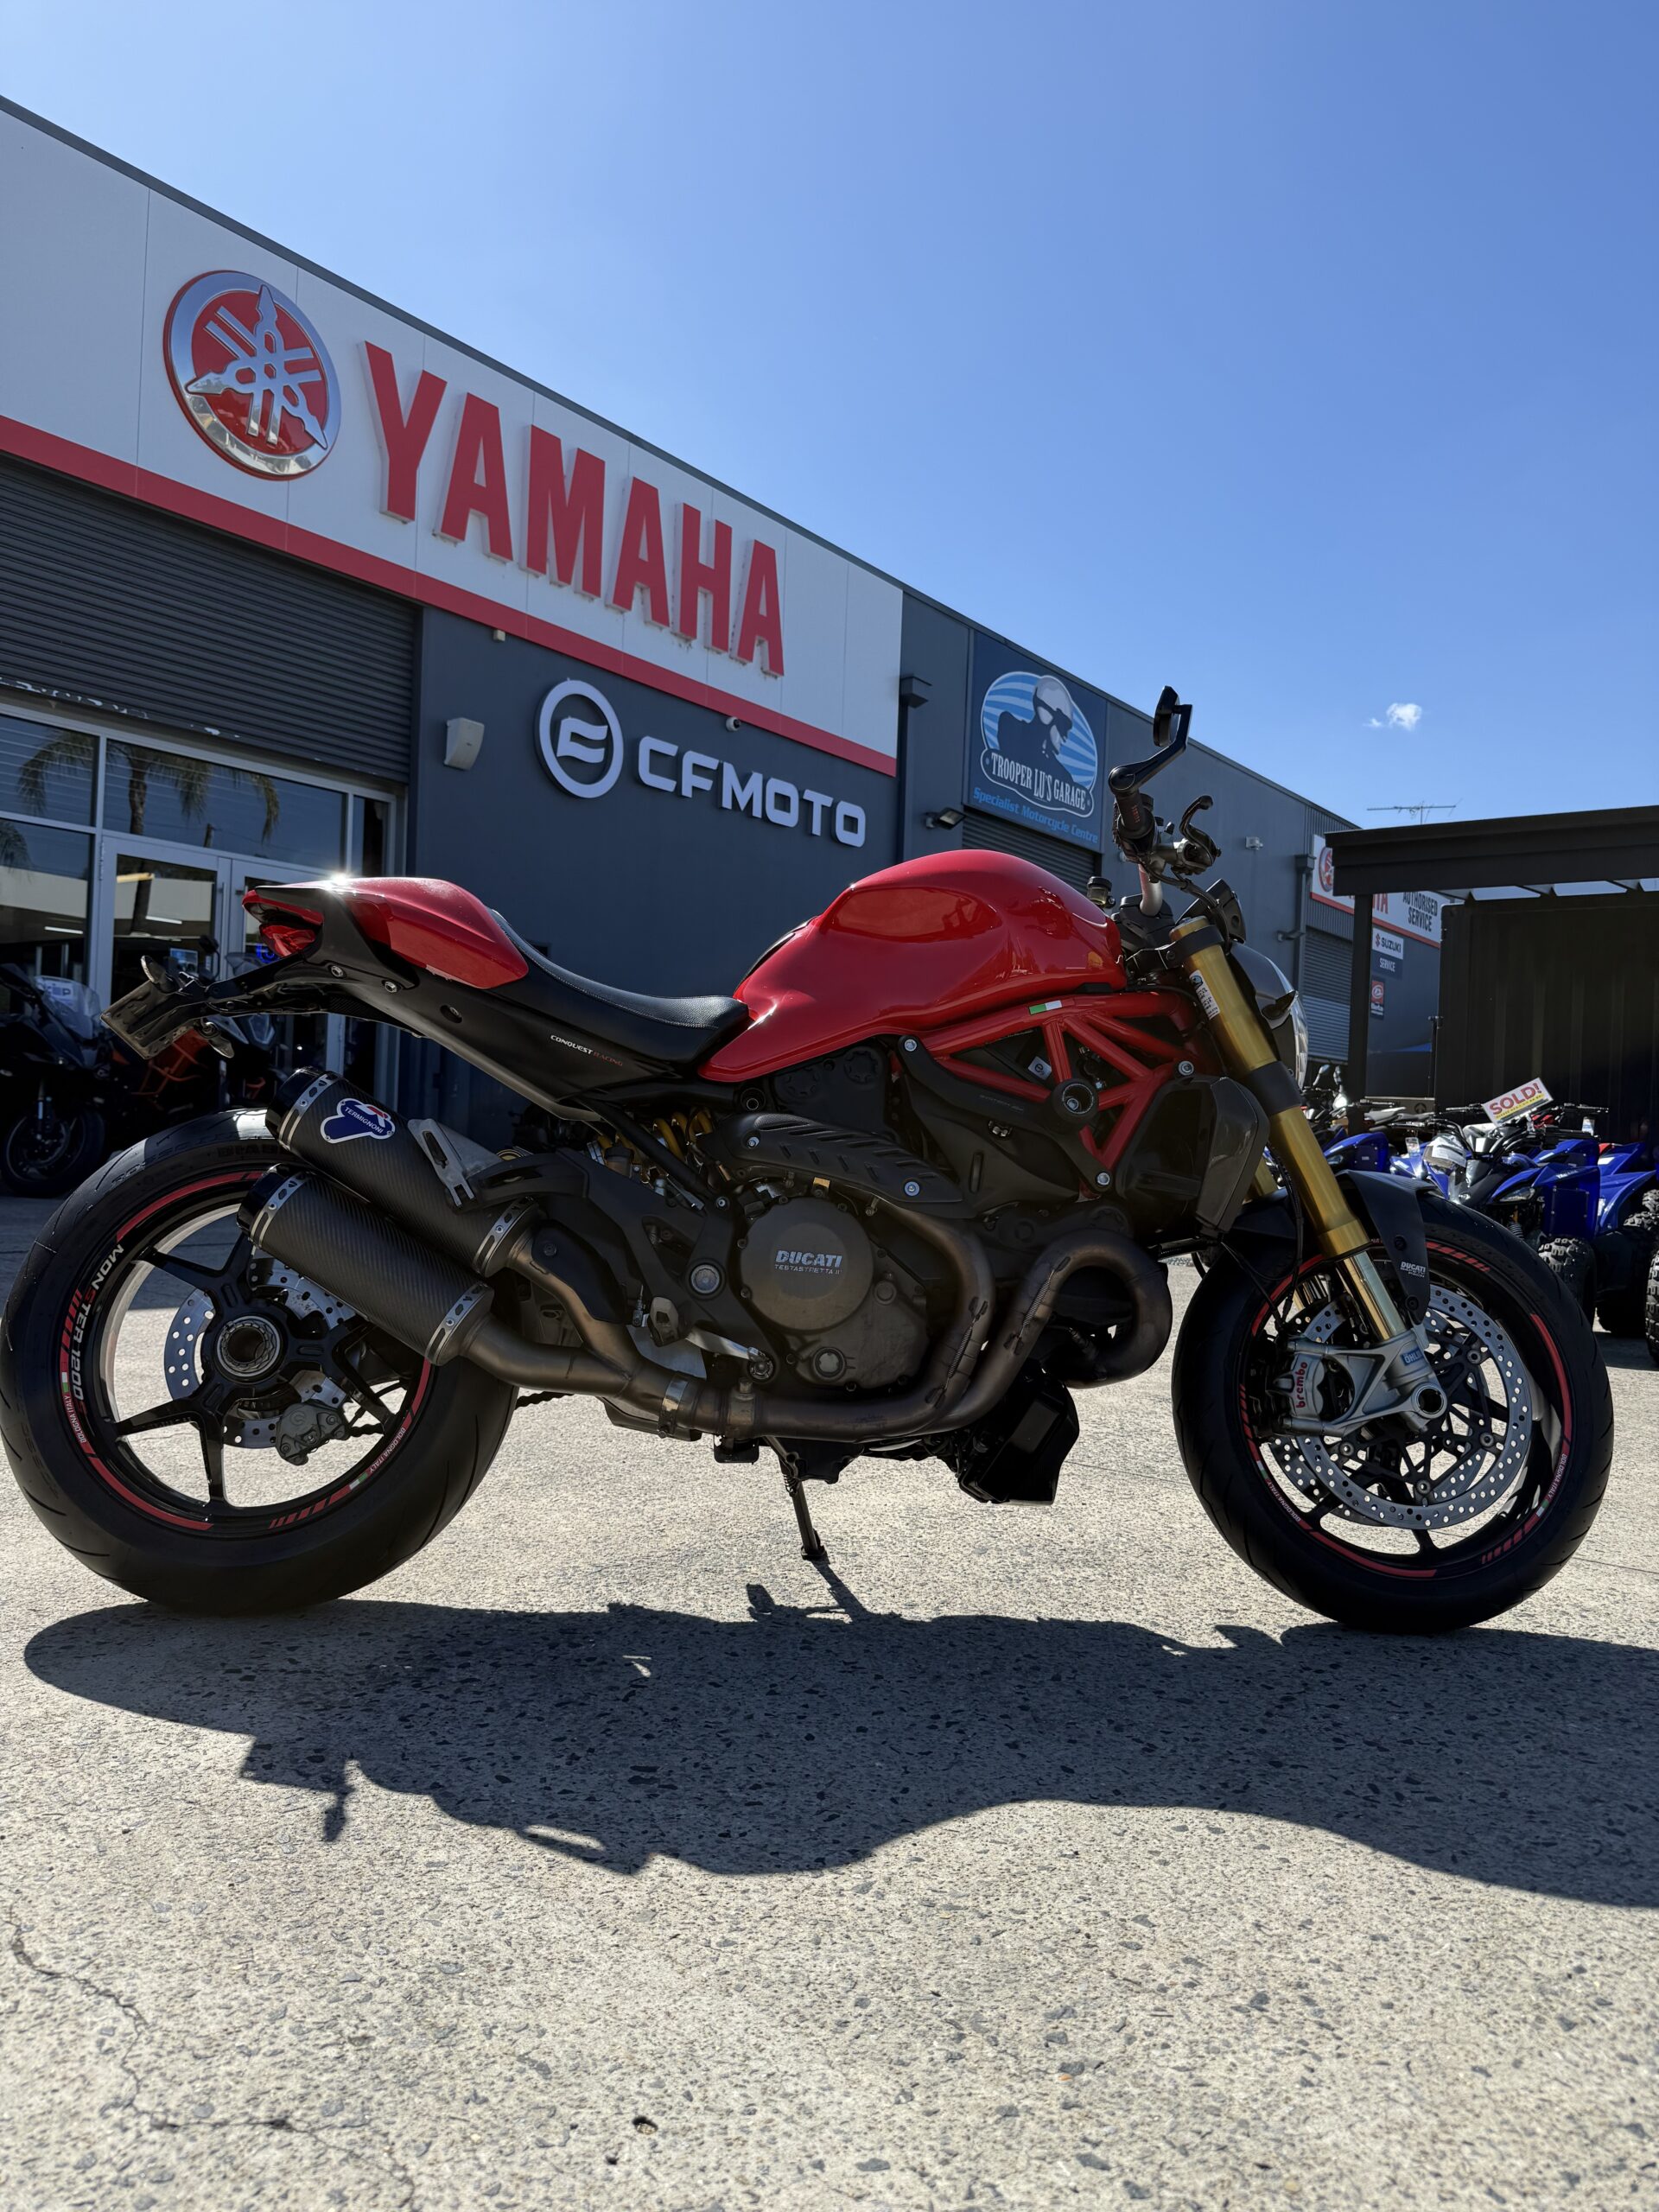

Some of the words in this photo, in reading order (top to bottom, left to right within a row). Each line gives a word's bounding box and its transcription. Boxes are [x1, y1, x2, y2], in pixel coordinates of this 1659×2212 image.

[359, 340, 785, 677] YAMAHA
[638, 735, 867, 849] CFMOTO
[991, 752, 1033, 790] TROOPER
[1033, 769, 1052, 802] LU'S
[1054, 779, 1086, 810] GARAGE
[973, 787, 1020, 814] Specialist
[1022, 805, 1071, 834] Motorcycle
[1071, 824, 1098, 843] Centre
[1402, 891, 1438, 917] AUTHORISED
[1408, 906, 1433, 932] SERVICE
[1381, 937, 1402, 953] SUZUKI
[1379, 957, 1395, 972] SERVICE
[550, 1034, 594, 1055] CONQUEST
[1489, 1082, 1542, 1116] SOLD!
[345, 1107, 384, 1134] TERMIGNONI
[774, 1263, 833, 1274] TESTASTRETTA
[775, 1249, 842, 1268] DUCATI
[1401, 1261, 1426, 1274] DUCATI
[73, 1243, 124, 1344] MONSTER
[1296, 1362, 1307, 1408] brembo
[63, 1395, 74, 1413] ITALY
[70, 1414, 86, 1443] BOLOGNA
[383, 1427, 406, 1457] BOLOGNA
[370, 1456, 385, 1472] ITALY
[1554, 1453, 1567, 1482] BOLOGNA
[1548, 1482, 1558, 1498] ITALY
